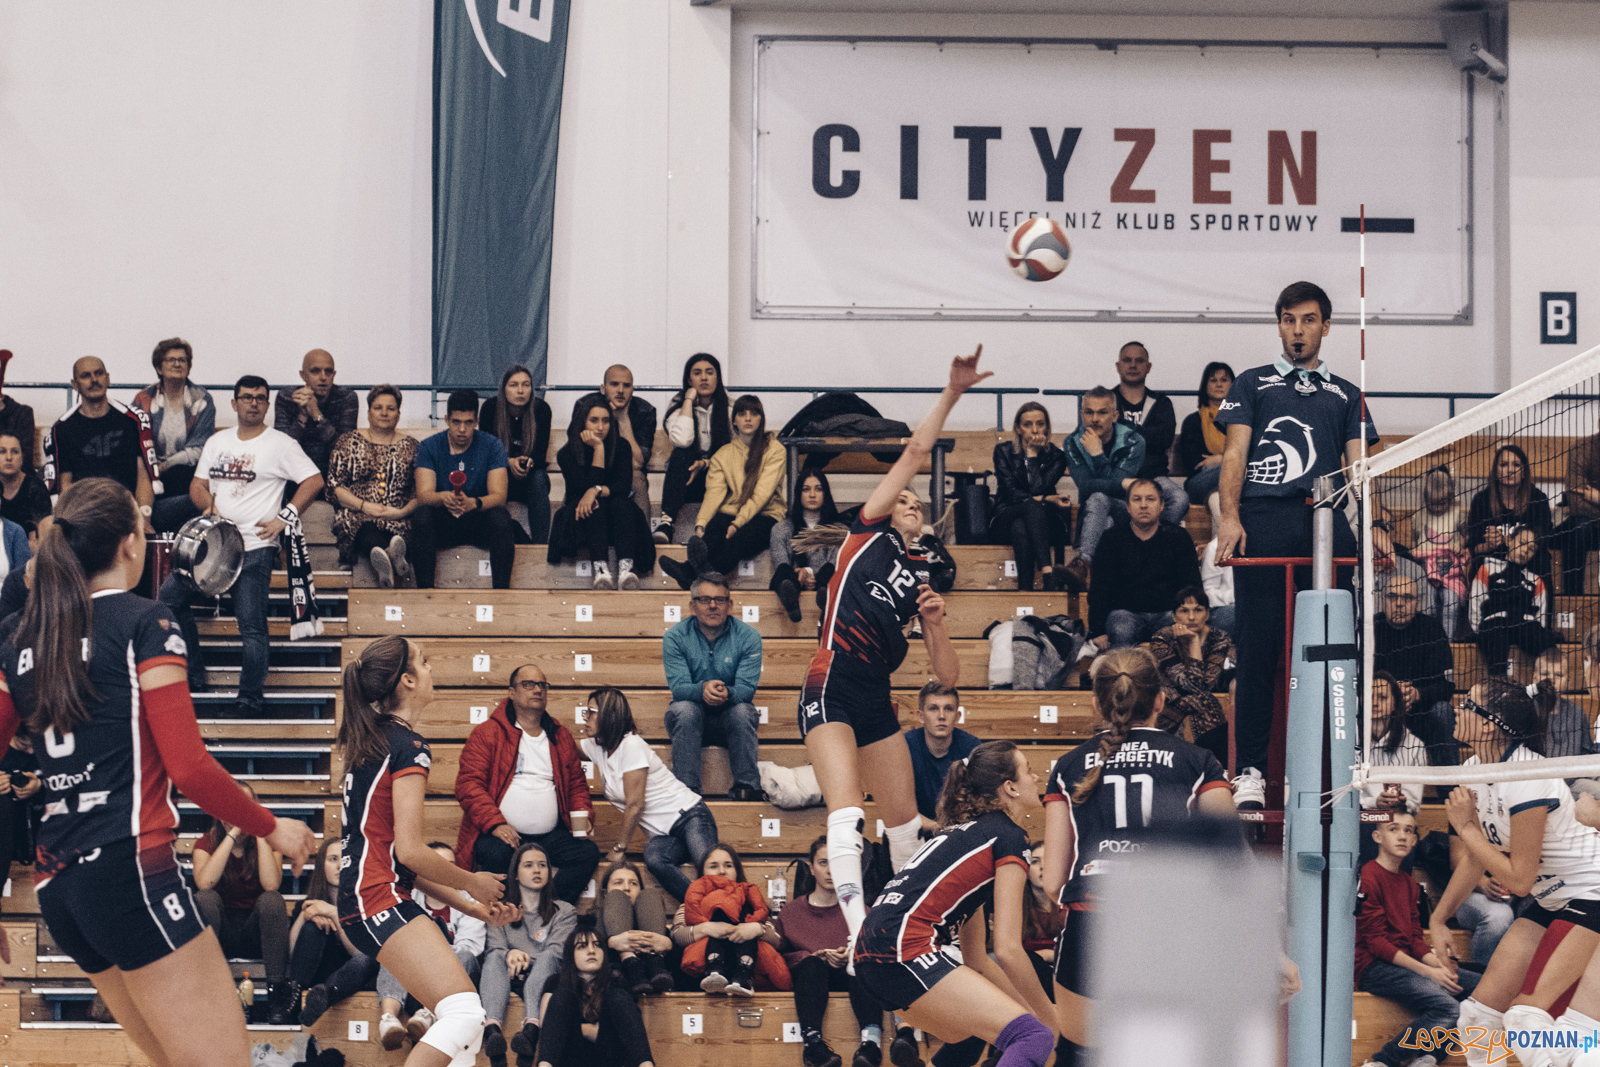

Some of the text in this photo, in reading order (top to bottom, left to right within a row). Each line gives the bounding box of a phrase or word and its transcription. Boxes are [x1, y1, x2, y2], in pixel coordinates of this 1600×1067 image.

[812, 123, 1317, 205] CITYZEN
[1065, 210, 1102, 229] NIŻ
[1116, 213, 1175, 230] KLUB
[1190, 213, 1318, 232] SPORTOWY
[1546, 300, 1571, 336] B
[887, 559, 915, 598] 12
[805, 701, 820, 718] 12
[1332, 684, 1346, 740] Senoh
[1120, 741, 1149, 752] NEA
[1103, 774, 1154, 828] 11
[1360, 813, 1390, 822] Senoh
[1482, 821, 1502, 846] 18
[163, 893, 185, 921] 8
[913, 952, 939, 970] 10
[689, 1018, 696, 1027] 5
